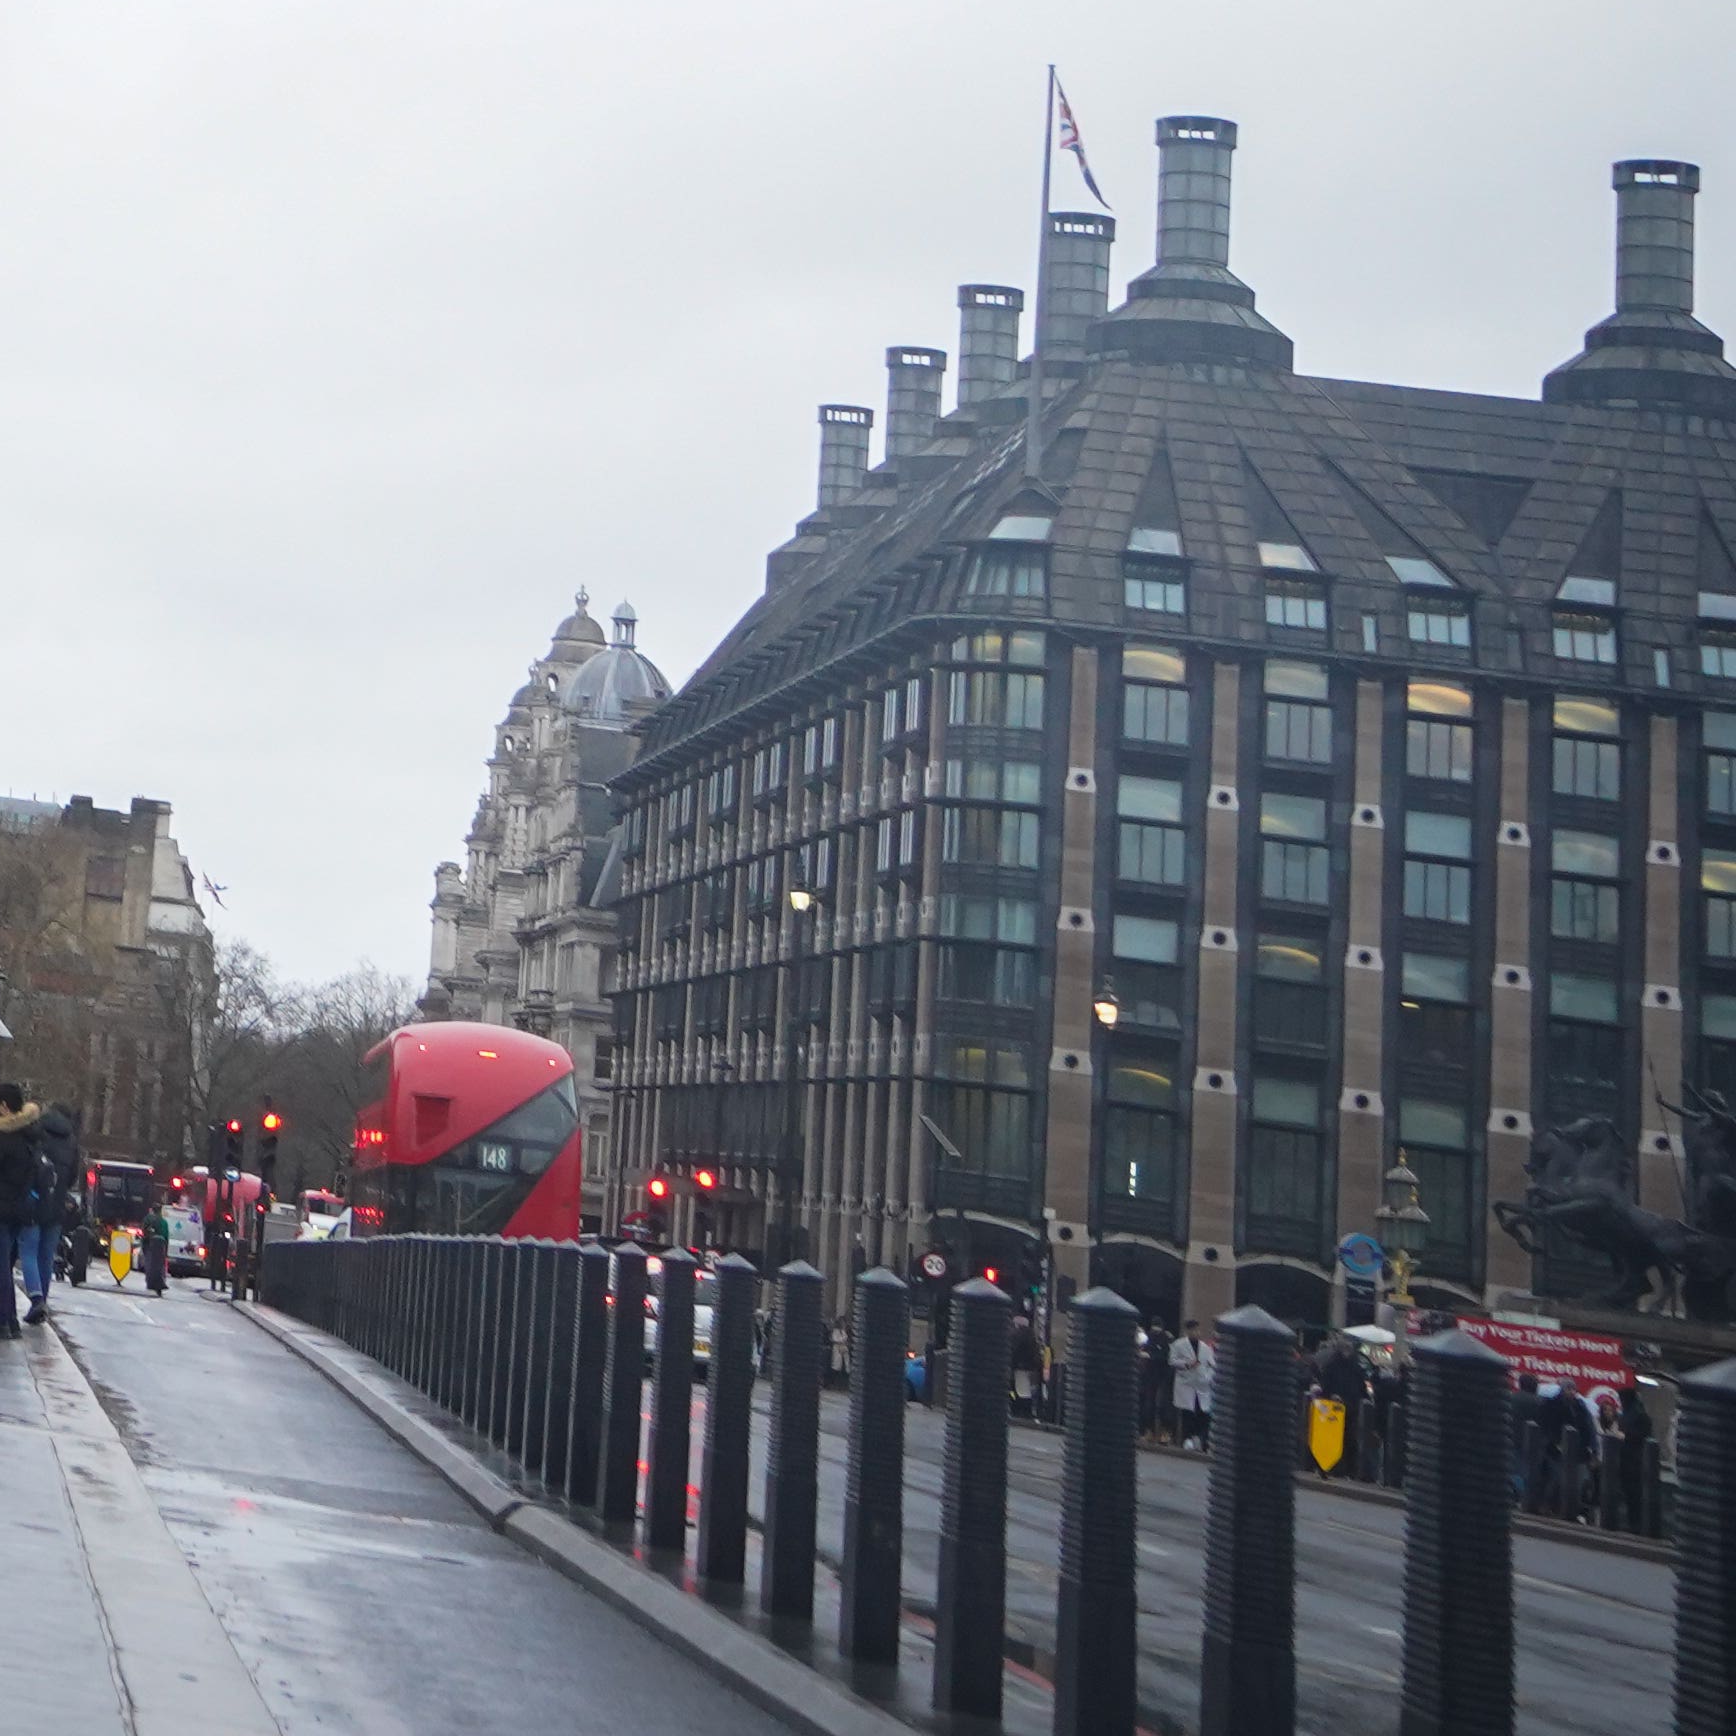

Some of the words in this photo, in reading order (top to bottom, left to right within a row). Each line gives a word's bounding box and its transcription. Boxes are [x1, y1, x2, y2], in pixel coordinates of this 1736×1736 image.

[482, 1145, 507, 1170] 148
[926, 1258, 945, 1272] 20
[1458, 1319, 1487, 1338] Buy
[1489, 1324, 1523, 1341] Your
[1525, 1329, 1577, 1349] Tickets
[1579, 1336, 1619, 1356] Here!
[1524, 1355, 1580, 1377] Tickets
[1581, 1363, 1626, 1385] Here!
